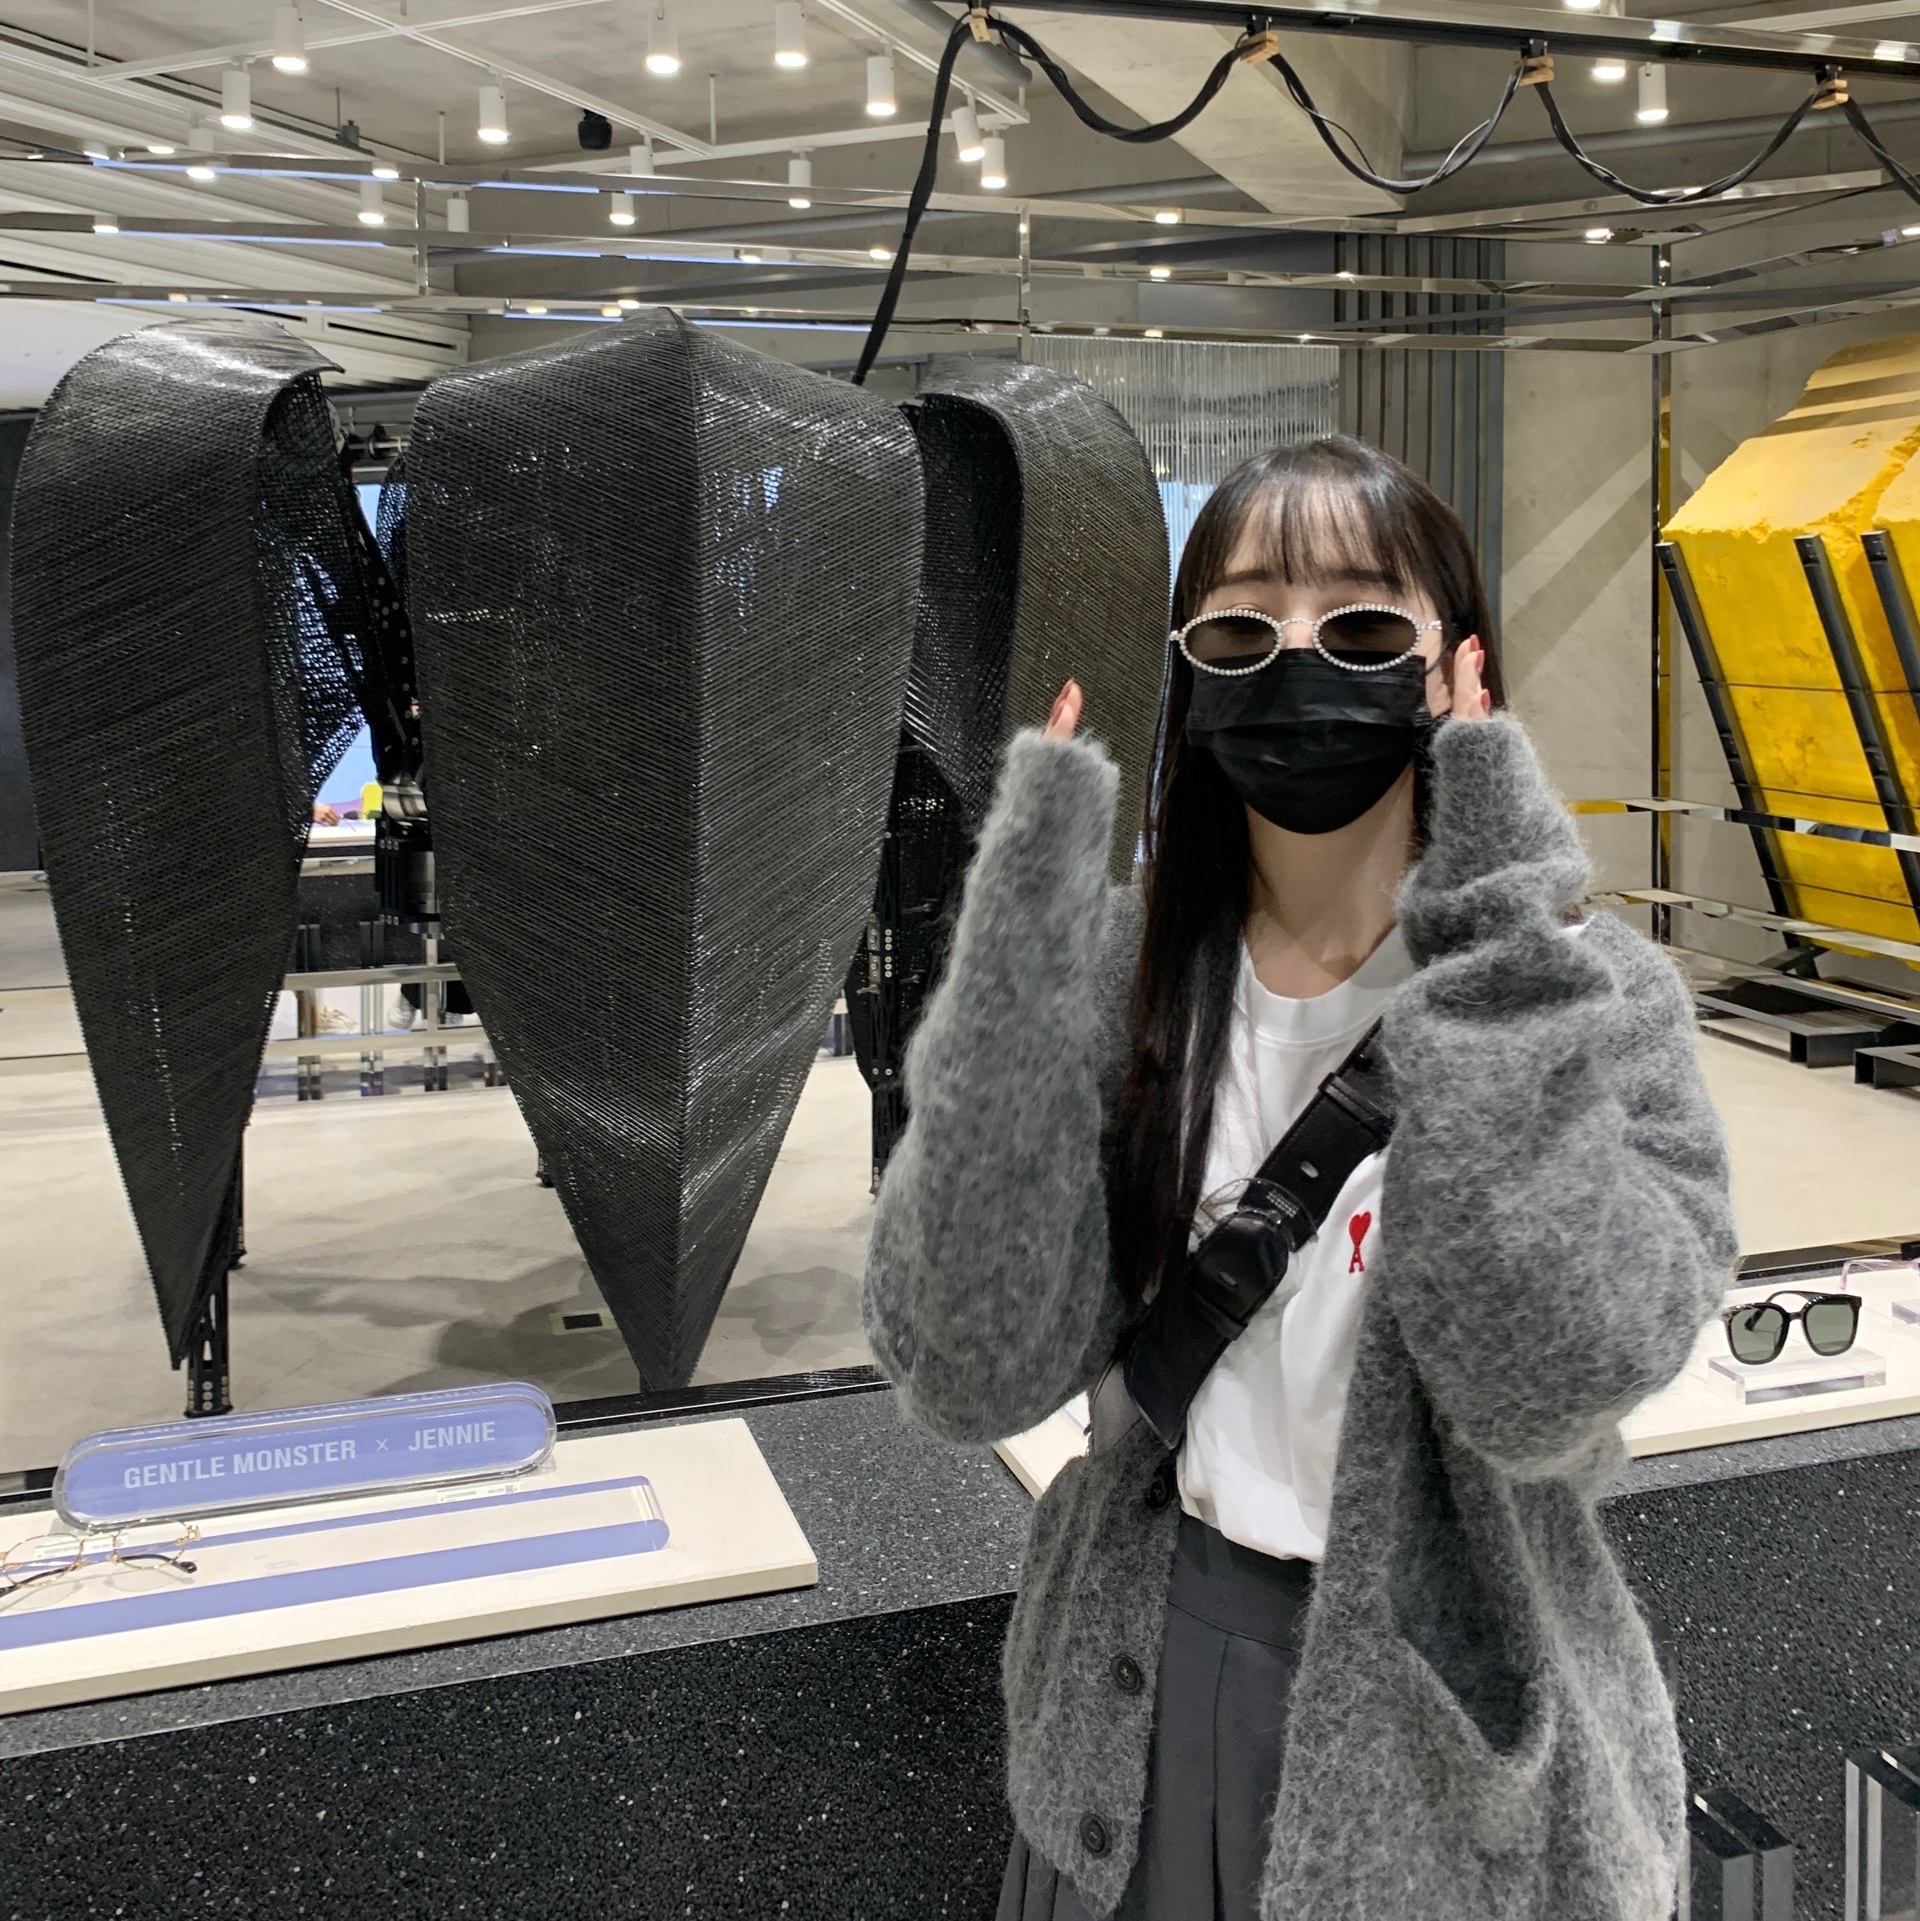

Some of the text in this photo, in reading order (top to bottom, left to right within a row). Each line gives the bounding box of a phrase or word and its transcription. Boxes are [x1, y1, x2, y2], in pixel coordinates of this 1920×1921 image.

[124, 1456, 225, 1489] GENTLE
[233, 1440, 356, 1475] MONSTER
[408, 1421, 496, 1451] JENNIE
